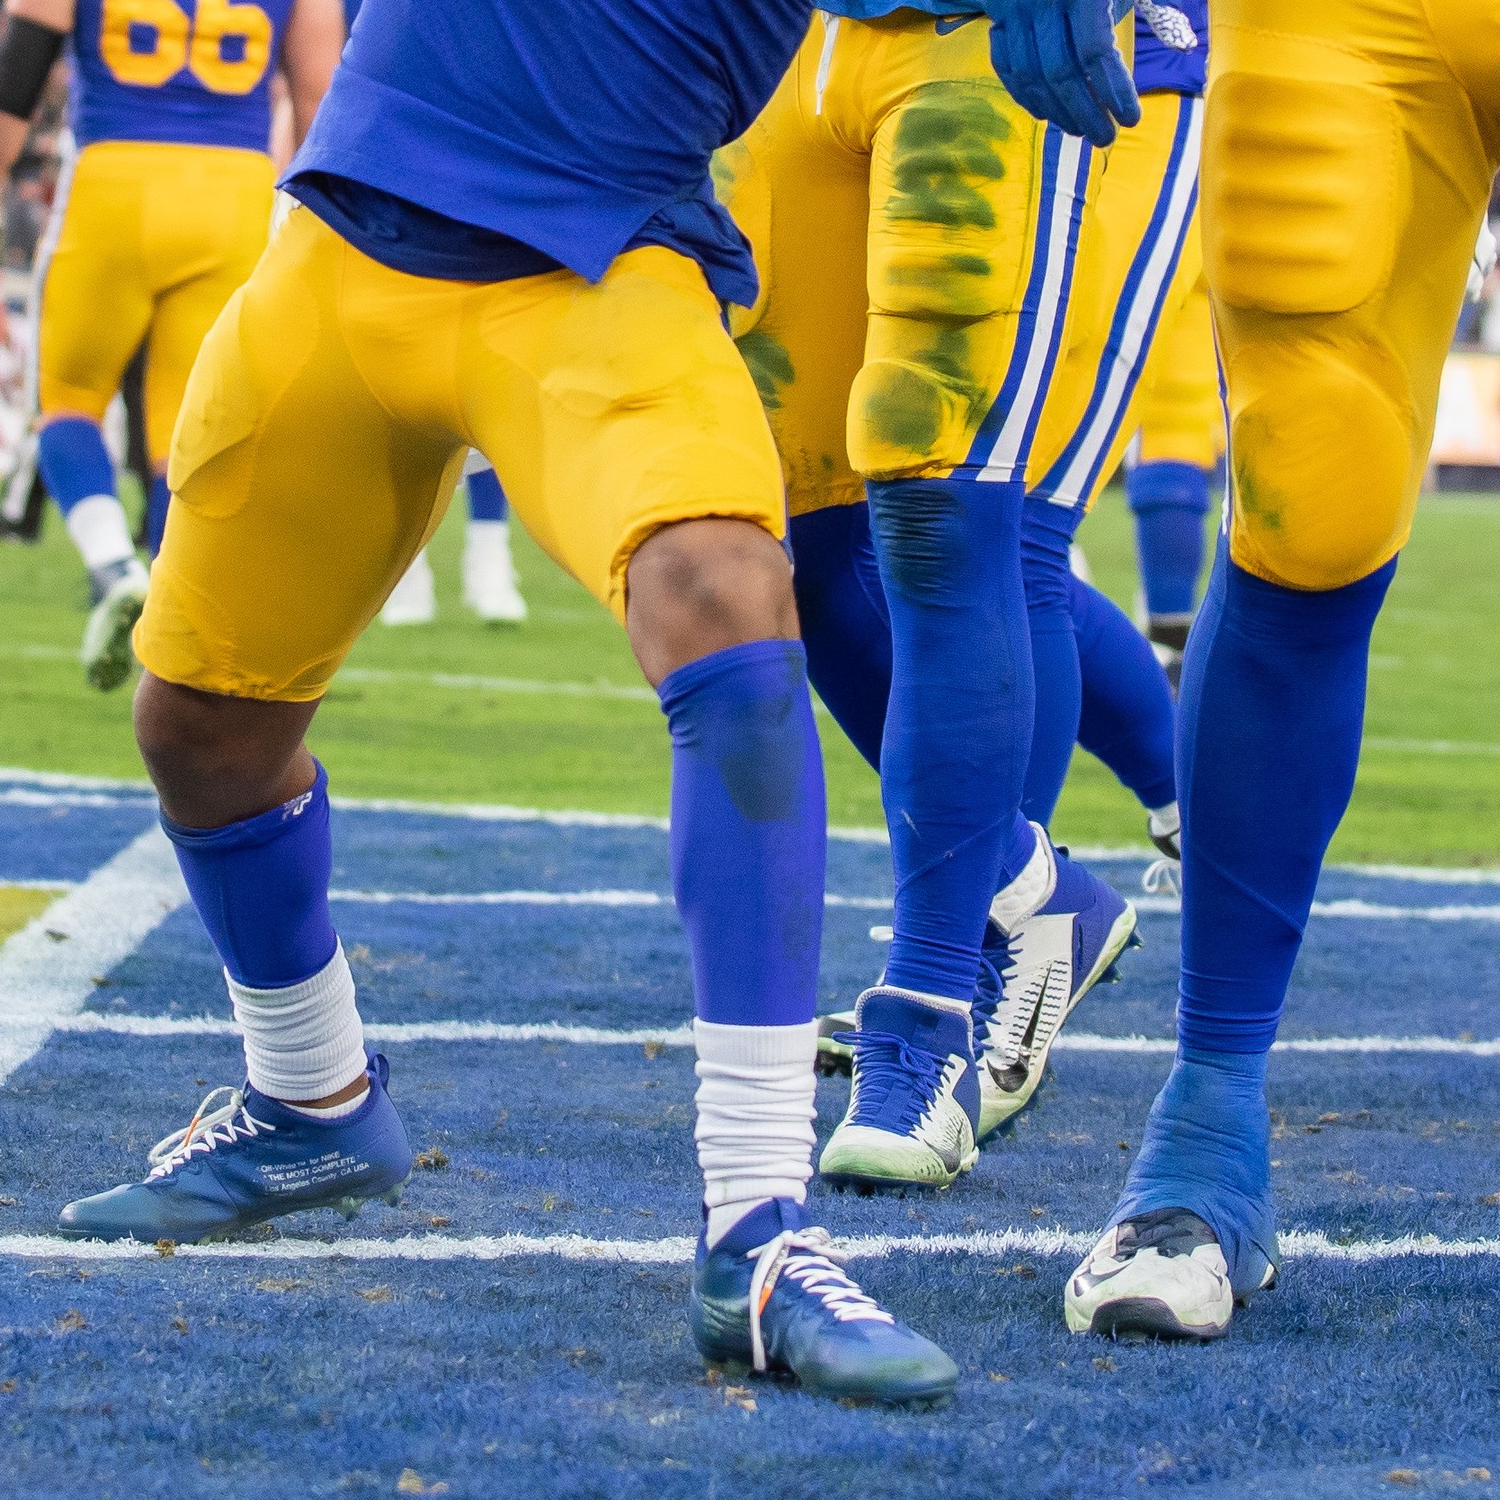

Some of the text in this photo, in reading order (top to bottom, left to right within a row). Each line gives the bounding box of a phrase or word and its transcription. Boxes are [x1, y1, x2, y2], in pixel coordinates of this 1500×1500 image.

[320, 1150, 340, 1162] NIKE
[353, 1162, 370, 1173] USA
[286, 1168, 309, 1179] MOST
